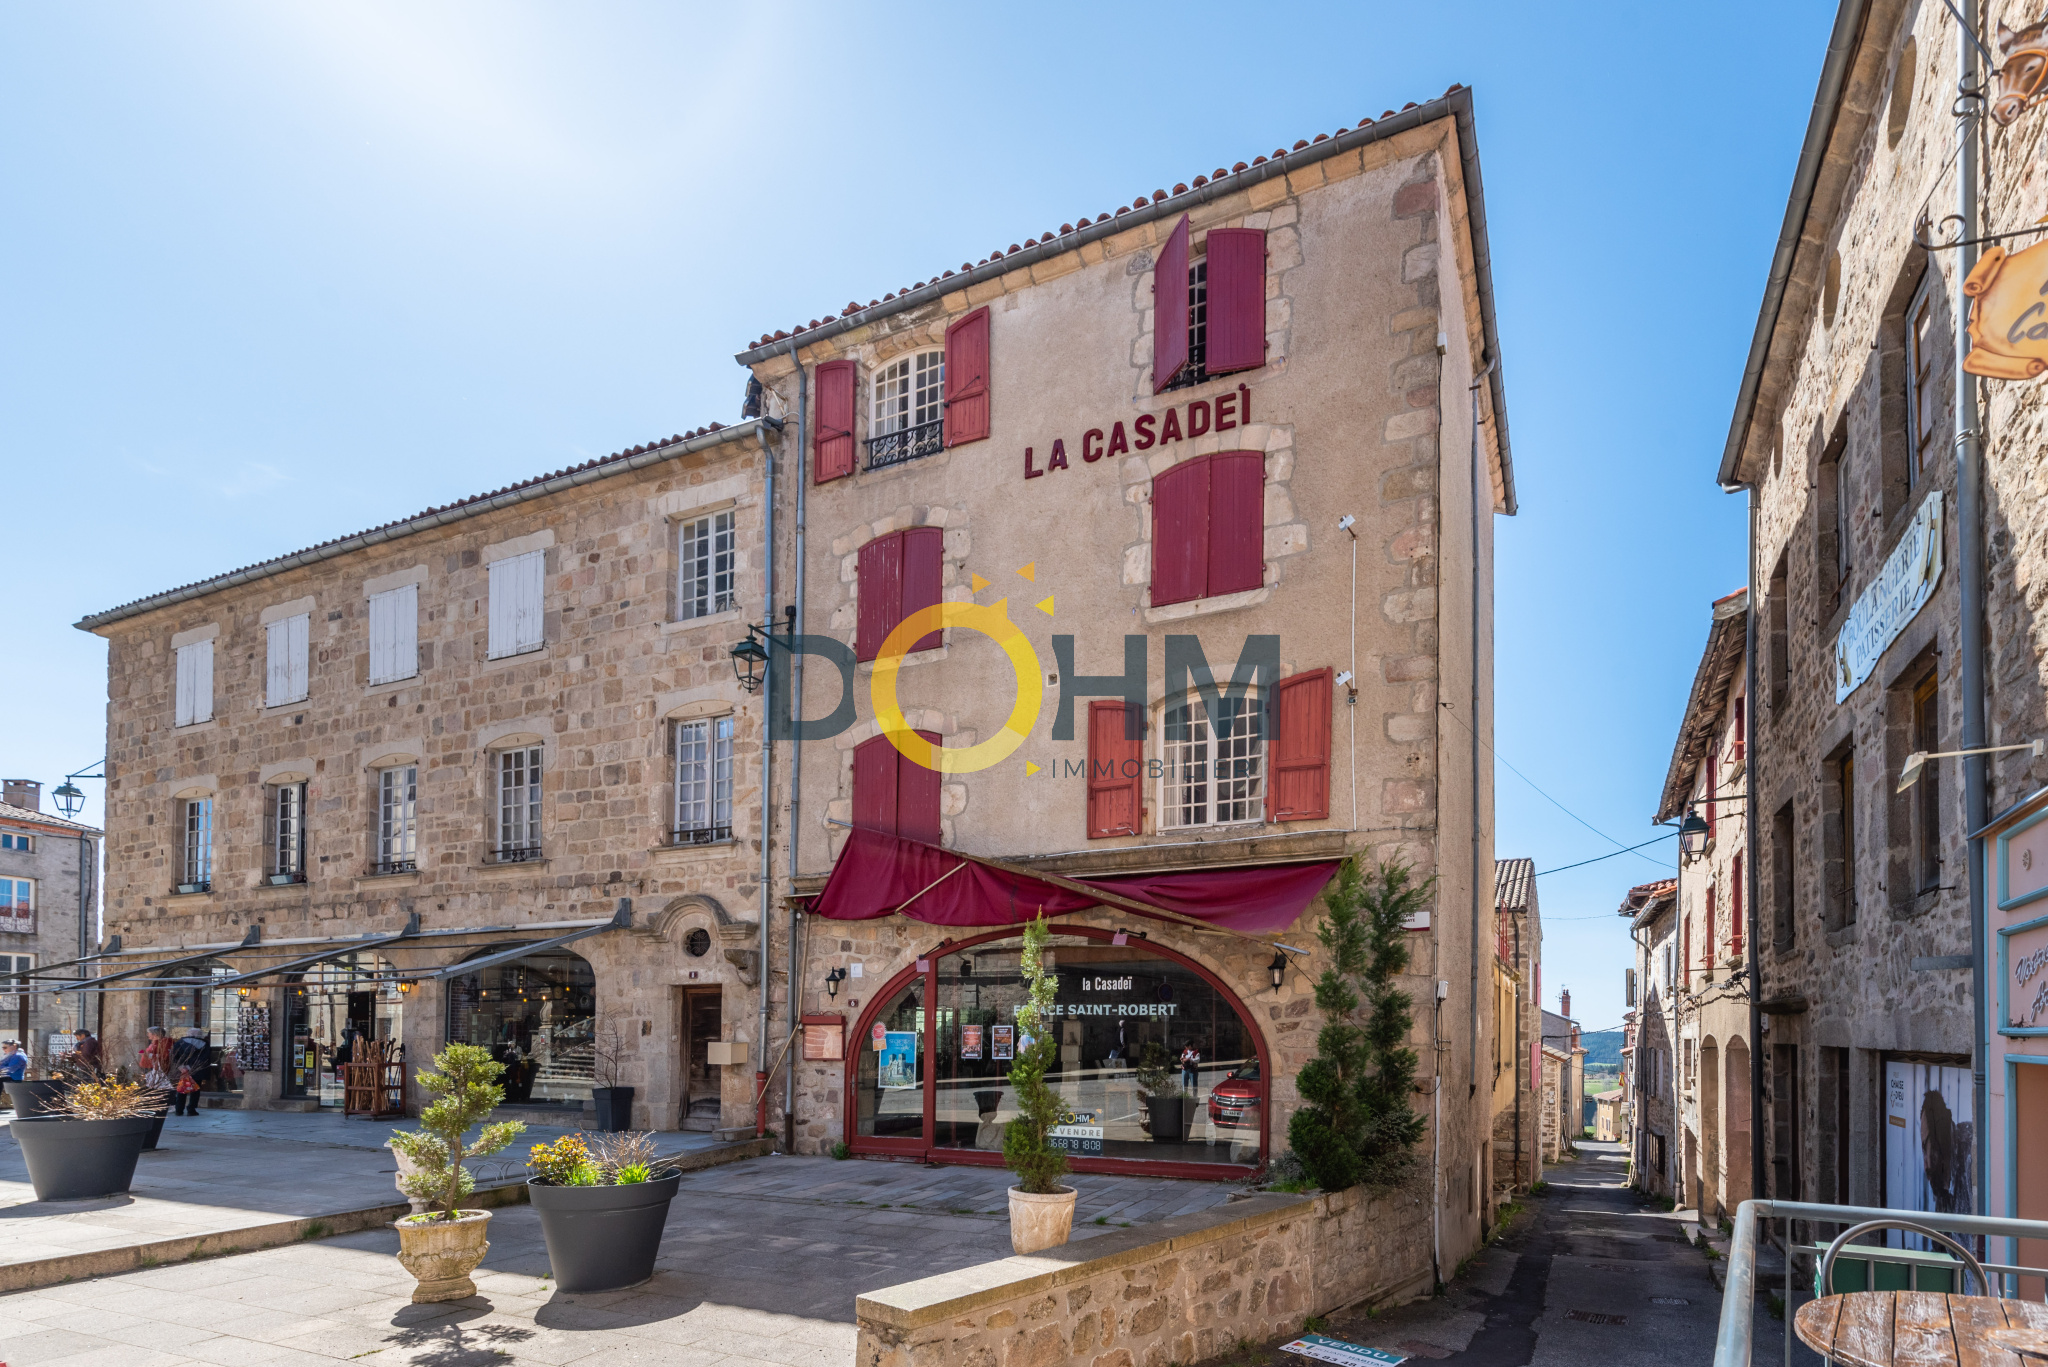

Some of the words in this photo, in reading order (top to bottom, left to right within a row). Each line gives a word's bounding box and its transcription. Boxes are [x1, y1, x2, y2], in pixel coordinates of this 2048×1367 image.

[1024, 438, 1069, 480] LA
[1848, 528, 1921, 649] BOULANGERIE
[1855, 579, 1911, 668] PATISSERIE
[1082, 977, 1091, 990] la
[1094, 976, 1132, 990] Casadeï
[1068, 1004, 1177, 1016] SAINT-ROBERT
[1060, 1128, 1101, 1137] VENDRE
[1091, 1140, 1101, 1151] 08
[1318, 1338, 1390, 1359] VENDU
